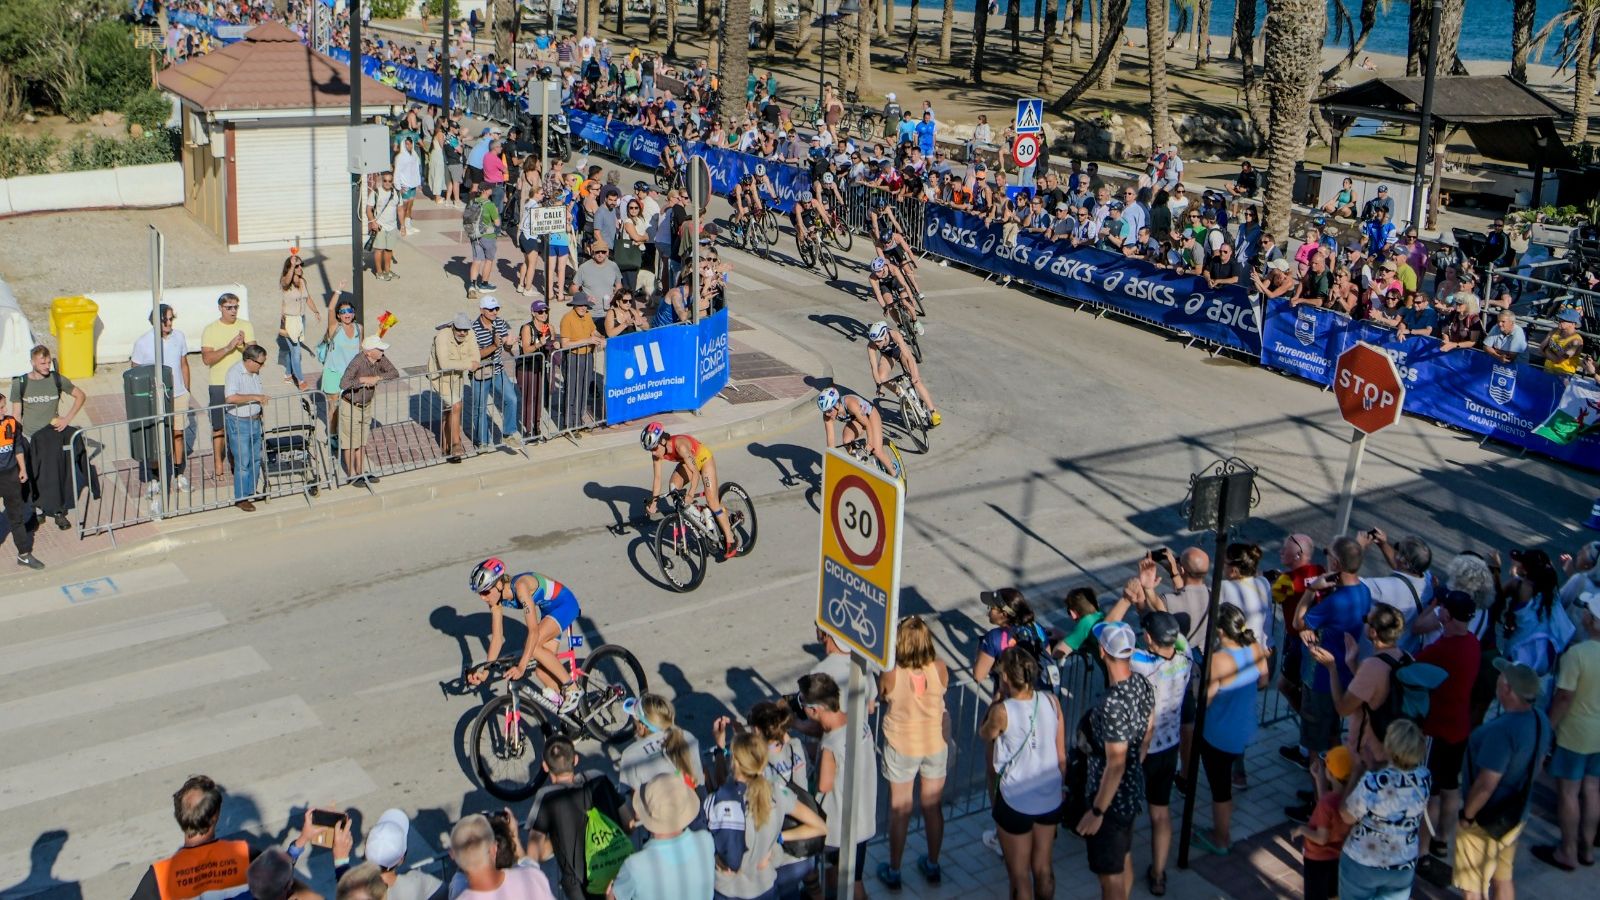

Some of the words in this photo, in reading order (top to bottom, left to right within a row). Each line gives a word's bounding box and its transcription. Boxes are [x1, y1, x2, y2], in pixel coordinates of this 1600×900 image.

[644, 139, 659, 149] World
[1019, 145, 1034, 156] 30
[543, 211, 562, 220] CALLE
[941, 223, 978, 249] asics
[995, 239, 1033, 265] asics
[1050, 256, 1098, 284] asics
[1124, 277, 1175, 307] asics
[1274, 341, 1332, 368] Torremolinos
[1278, 355, 1325, 375] AYUNTAMIENTO
[608, 381, 647, 399] Diputación
[647, 375, 685, 388] Provincial
[626, 396, 636, 405] de
[637, 389, 663, 402] Málaga
[1339, 368, 1395, 409] STOP
[27, 395, 50, 404] BOSS
[1464, 397, 1534, 429] Torremolinos
[1467, 414, 1526, 438] AYUNTAMIENTO
[844, 501, 873, 539] 30
[824, 559, 886, 608] CICLOCALLE
[175, 860, 218, 878] PROTECCIÓN
[219, 858, 237, 868] CIVIL
[176, 867, 238, 888] TORREMOLINOS
